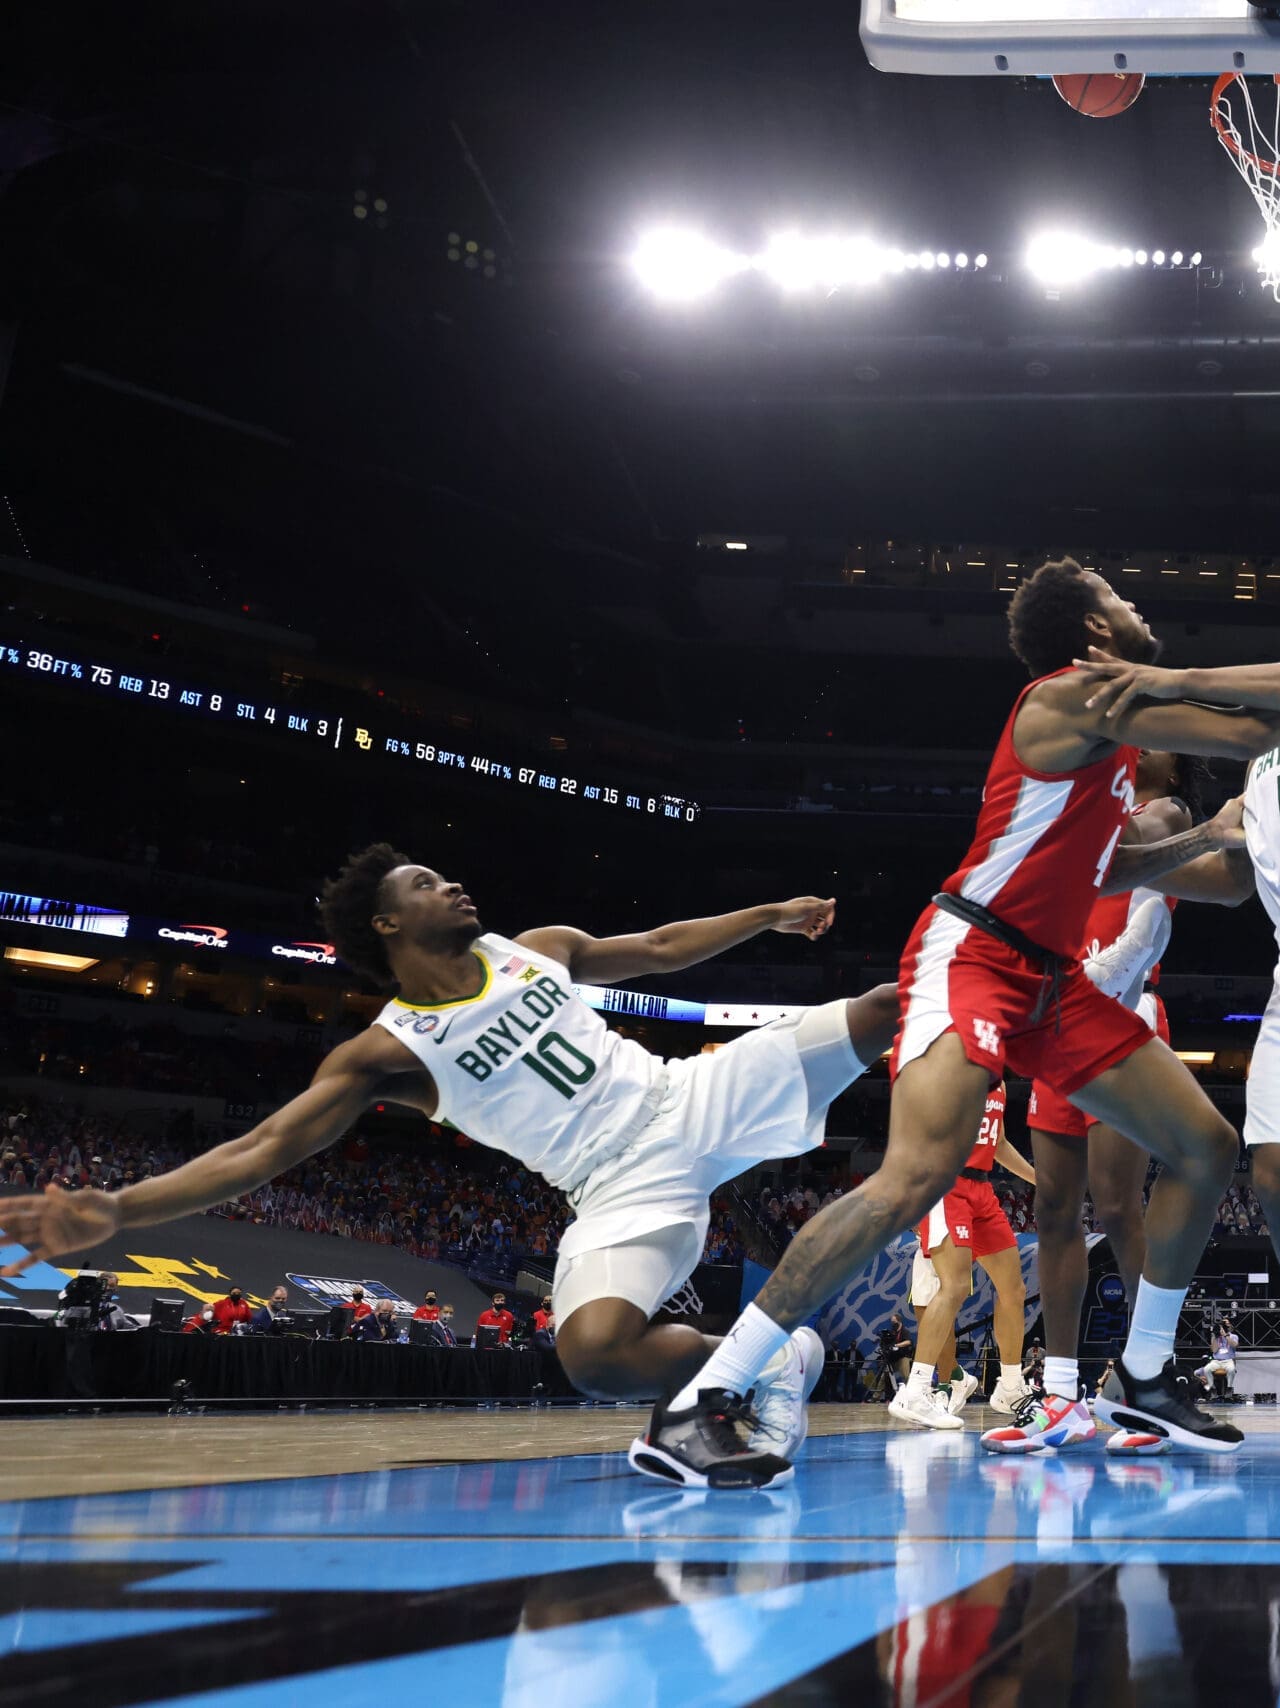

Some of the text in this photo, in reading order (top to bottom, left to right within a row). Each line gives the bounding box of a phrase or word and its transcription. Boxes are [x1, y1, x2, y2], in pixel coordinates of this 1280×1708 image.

[26, 650, 53, 671] 36
[90, 665, 113, 685] 75
[119, 675, 143, 693] REB
[148, 680, 170, 699] 13
[179, 690, 202, 707] AST
[209, 695, 223, 712] 8
[236, 703, 256, 720] STL
[264, 707, 276, 724] 4
[288, 715, 309, 732] BLK
[317, 720, 328, 736] 3
[415, 743, 435, 762] 56
[471, 756, 489, 775] 44
[518, 768, 536, 785] 67
[538, 775, 556, 791] REB
[560, 778, 577, 795] 22
[584, 785, 600, 801] AST
[603, 787, 618, 804] 15
[626, 795, 641, 811] STL
[647, 799, 655, 813] 6
[664, 804, 680, 819] BLK
[685, 807, 694, 822] 0
[455, 976, 570, 1082] BAYLOR
[603, 990, 669, 1018] #FINALFOUR
[521, 1031, 596, 1100] 10
[976, 1117, 999, 1146] 24
